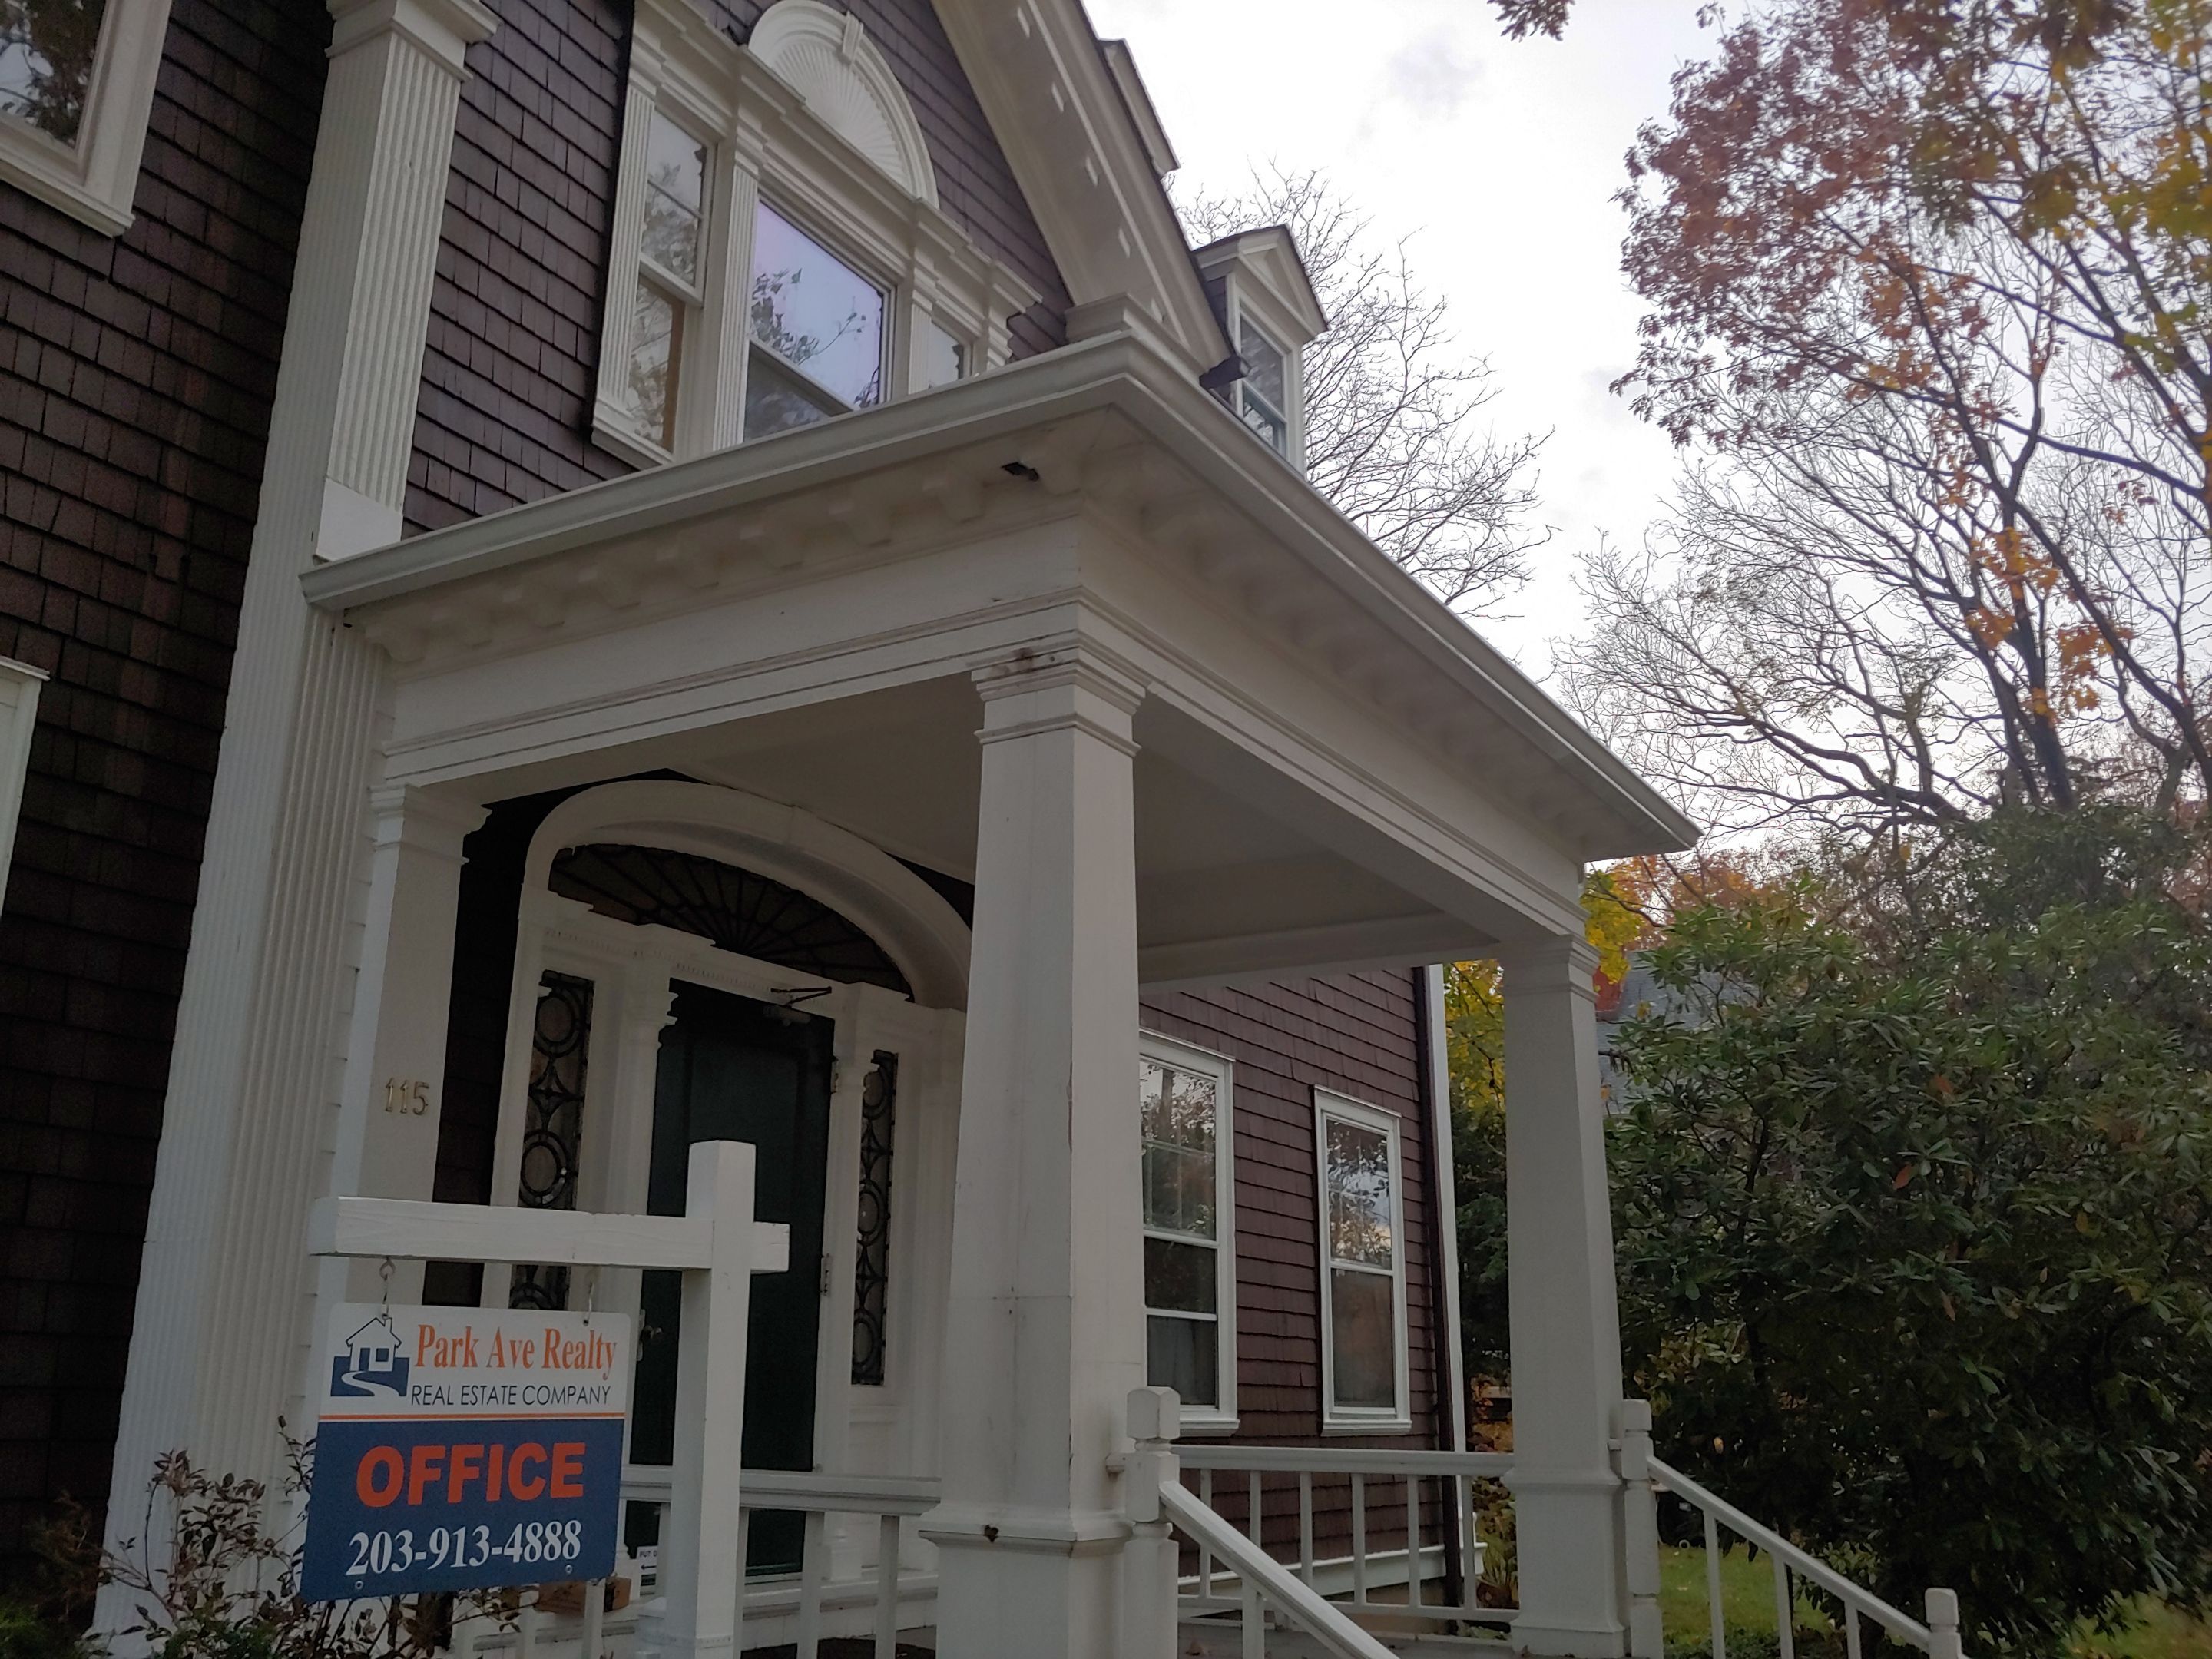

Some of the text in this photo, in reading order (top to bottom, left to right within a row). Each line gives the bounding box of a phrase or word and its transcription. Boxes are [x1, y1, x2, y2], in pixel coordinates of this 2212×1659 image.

[385, 1078, 429, 1115] 115
[414, 1325, 618, 1380] Park Ave Realty
[411, 1385, 611, 1406] REAL ESTATE COMPANY
[356, 1442, 586, 1508] OFFICE
[345, 1519, 581, 1575] 203-913-4888
